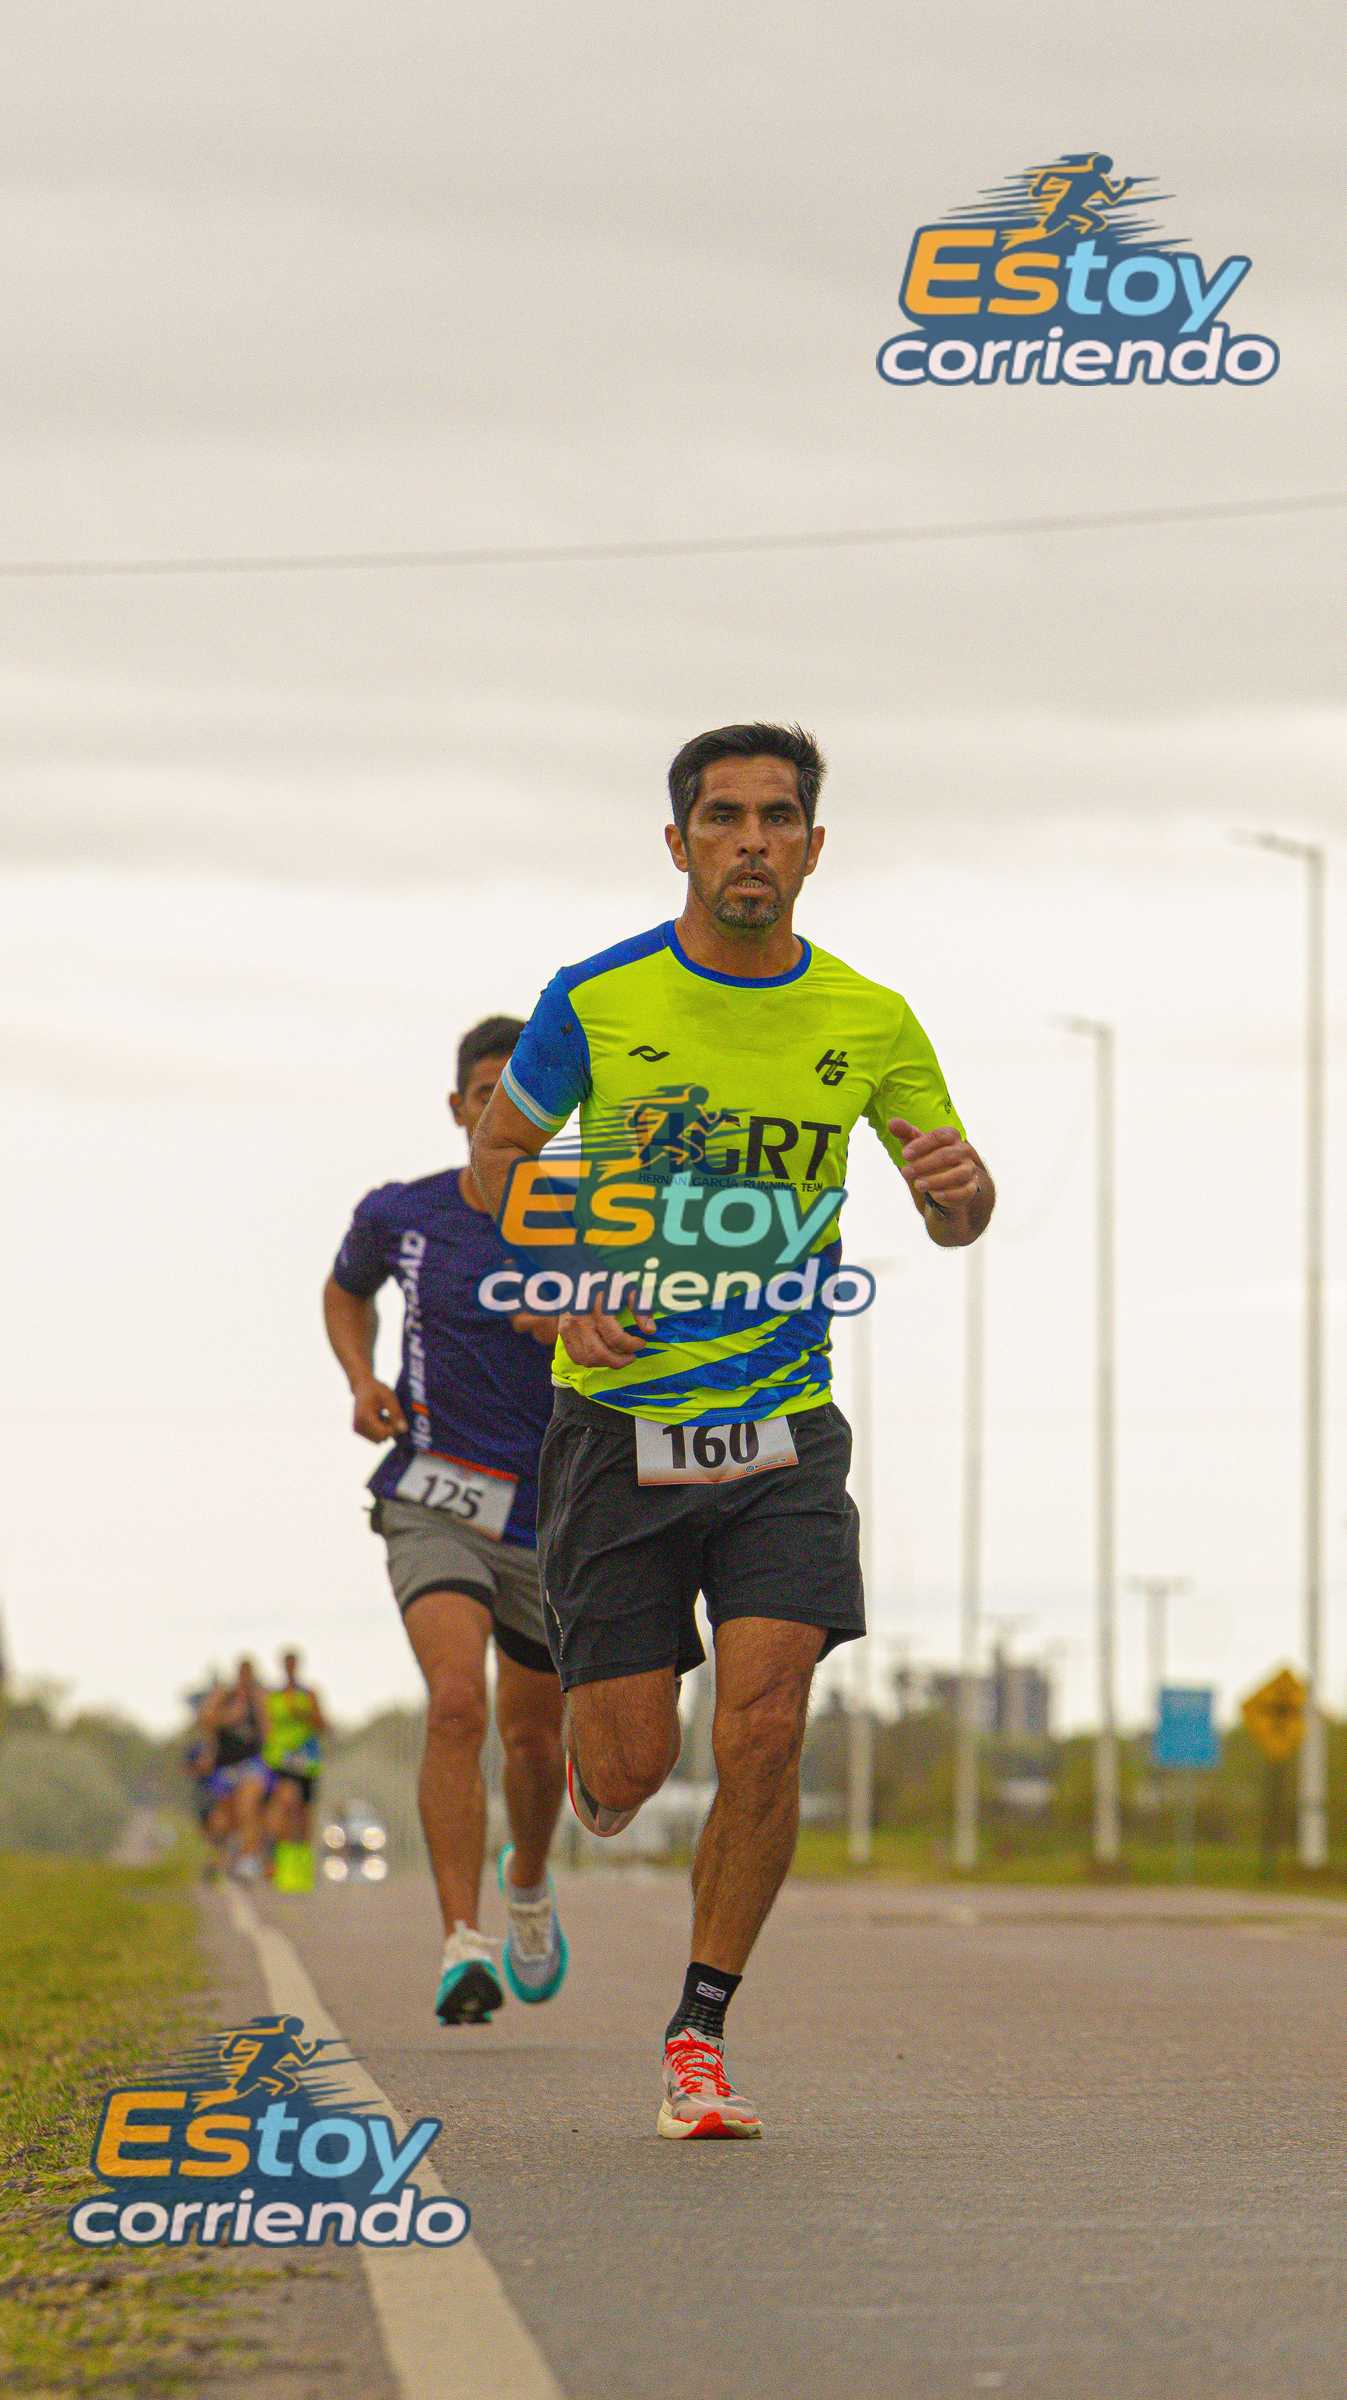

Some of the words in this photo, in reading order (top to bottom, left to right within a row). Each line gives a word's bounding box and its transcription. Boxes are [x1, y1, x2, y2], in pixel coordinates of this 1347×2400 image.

[743, 1180, 796, 1193] RUNNING
[801, 1182, 824, 1193] TEAM
[662, 1423, 760, 1469] 160
[421, 1474, 483, 1520] 125
